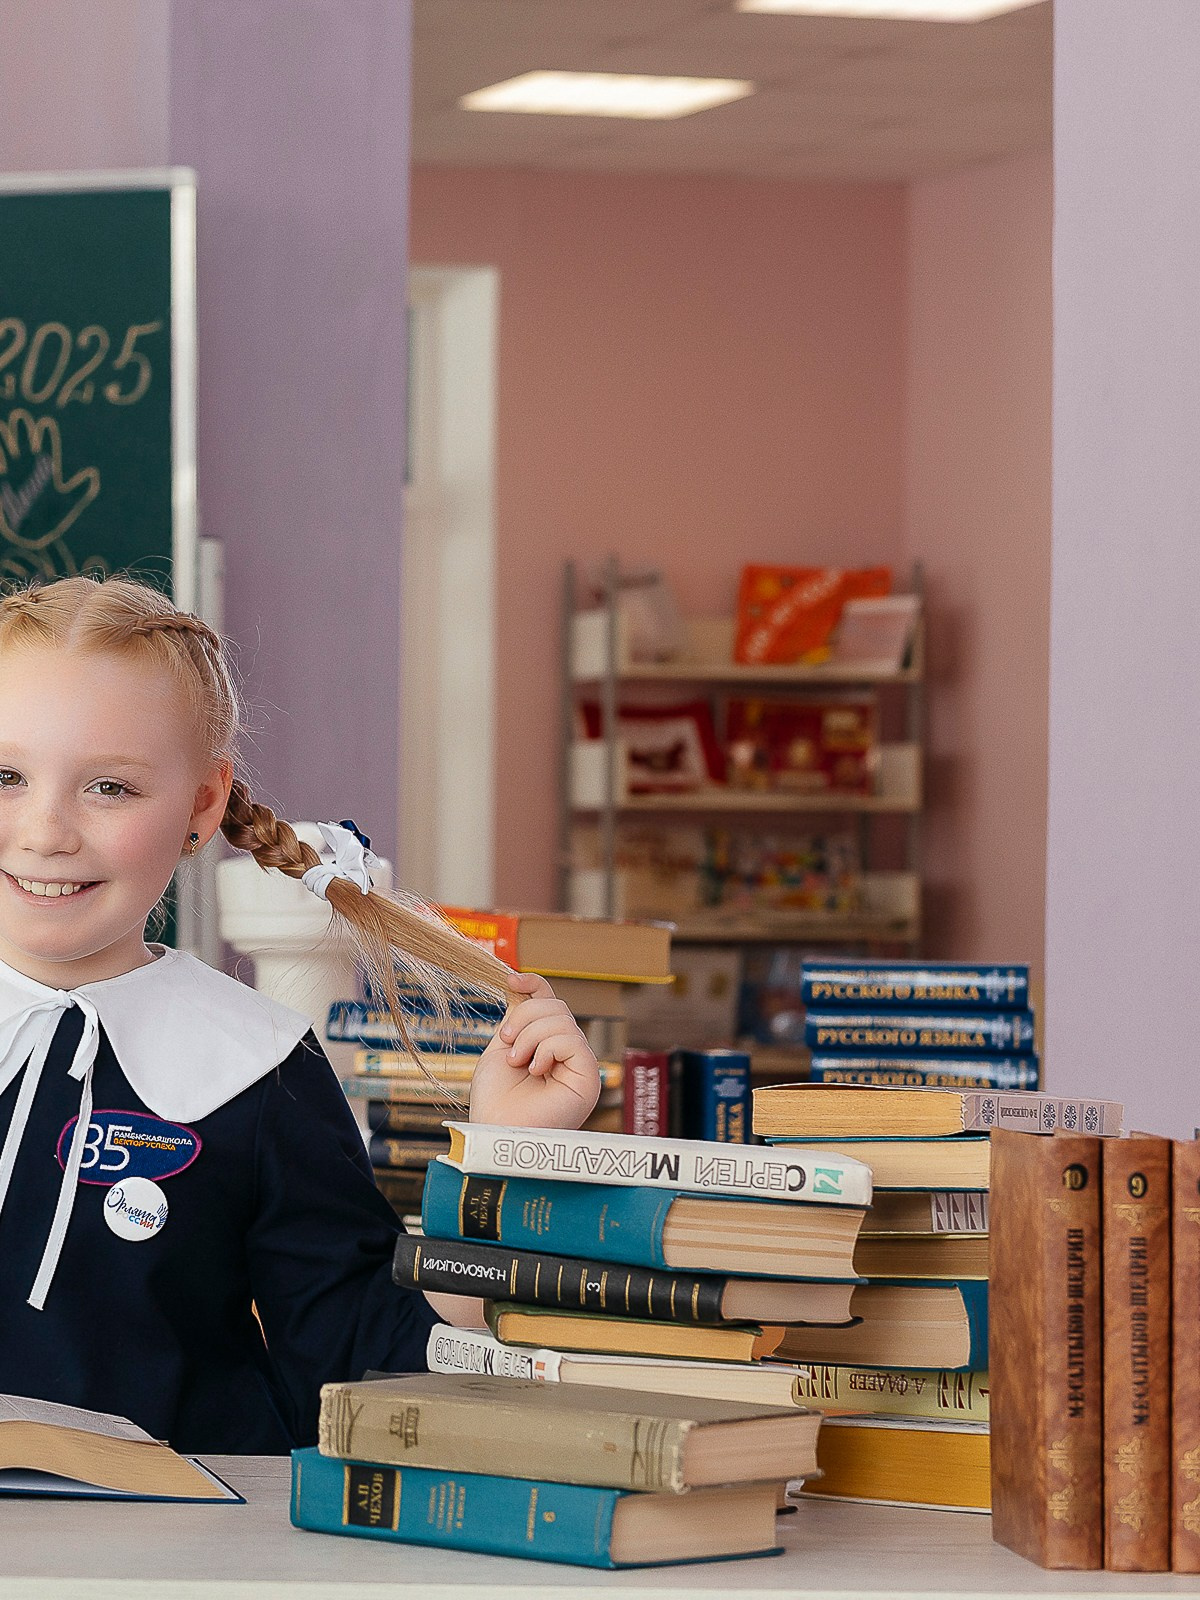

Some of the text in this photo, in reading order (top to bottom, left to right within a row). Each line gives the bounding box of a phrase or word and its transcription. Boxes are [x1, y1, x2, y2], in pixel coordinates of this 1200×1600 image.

[810, 982, 980, 1001] РУССКОГО ЯЗЫКА
[816, 1027, 987, 1048] РУССКОГО ЯЗЫКА
[492, 1138, 807, 1192] СЕРГЕЙ МИХАЛКОВ
[812, 1168, 844, 1194] 2
[1062, 1167, 1084, 1189] 10
[1130, 1174, 1145, 1196] 9
[106, 1187, 158, 1223] Орлята
[479, 1188, 492, 1229] ЧЕХОВ
[116, 1209, 155, 1230] РОССИИ
[586, 1281, 600, 1293] 3
[850, 1373, 927, 1395] А. ФАДЕЕВ
[370, 1472, 384, 1525] ЧЕХОВ
